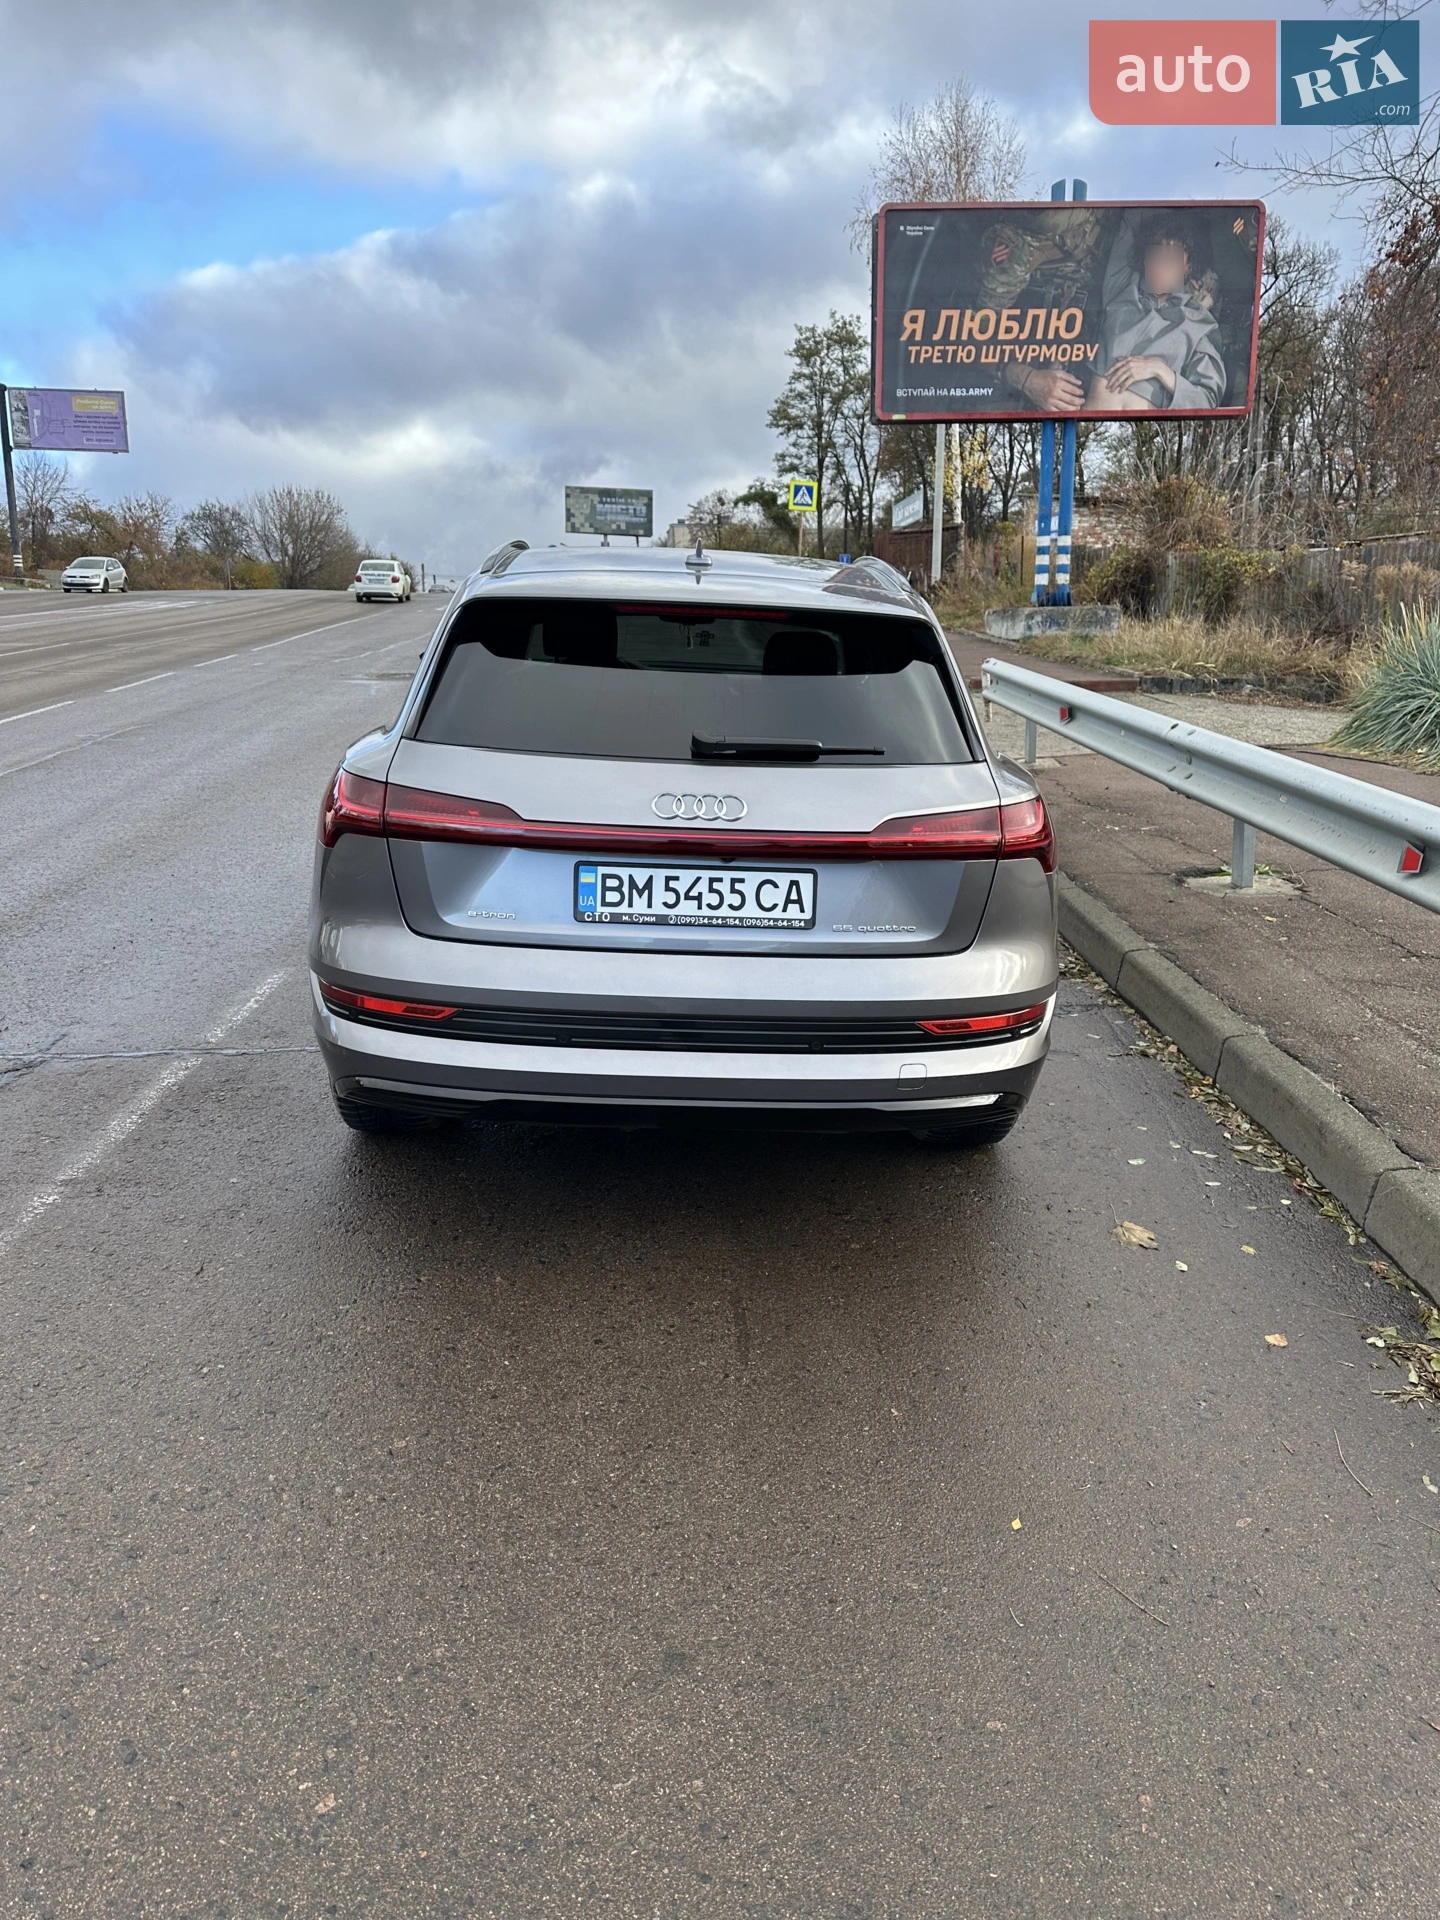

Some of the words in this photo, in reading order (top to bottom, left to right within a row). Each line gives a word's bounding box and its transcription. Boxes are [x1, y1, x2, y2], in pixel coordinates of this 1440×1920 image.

[899, 309, 925, 341] Я
[932, 307, 1083, 341] ЛЮБЛЮ
[908, 345, 976, 364] ТРЕТЮ
[980, 343, 1100, 364] ШТУРМОВУ
[896, 386, 936, 397] ВСТУПАЙ
[936, 388, 948, 397] НА
[600, 873, 654, 909] BM
[662, 875, 746, 911] 5455
[755, 878, 805, 914] CA
[580, 895, 595, 906] UA
[467, 910, 516, 919] e-tron
[584, 912, 611, 922] СТО
[632, 914, 656, 923] Суми
[743, 917, 805, 927] (096)54-64-154
[832, 924, 853, 933] 55
[857, 924, 917, 934] quattro
